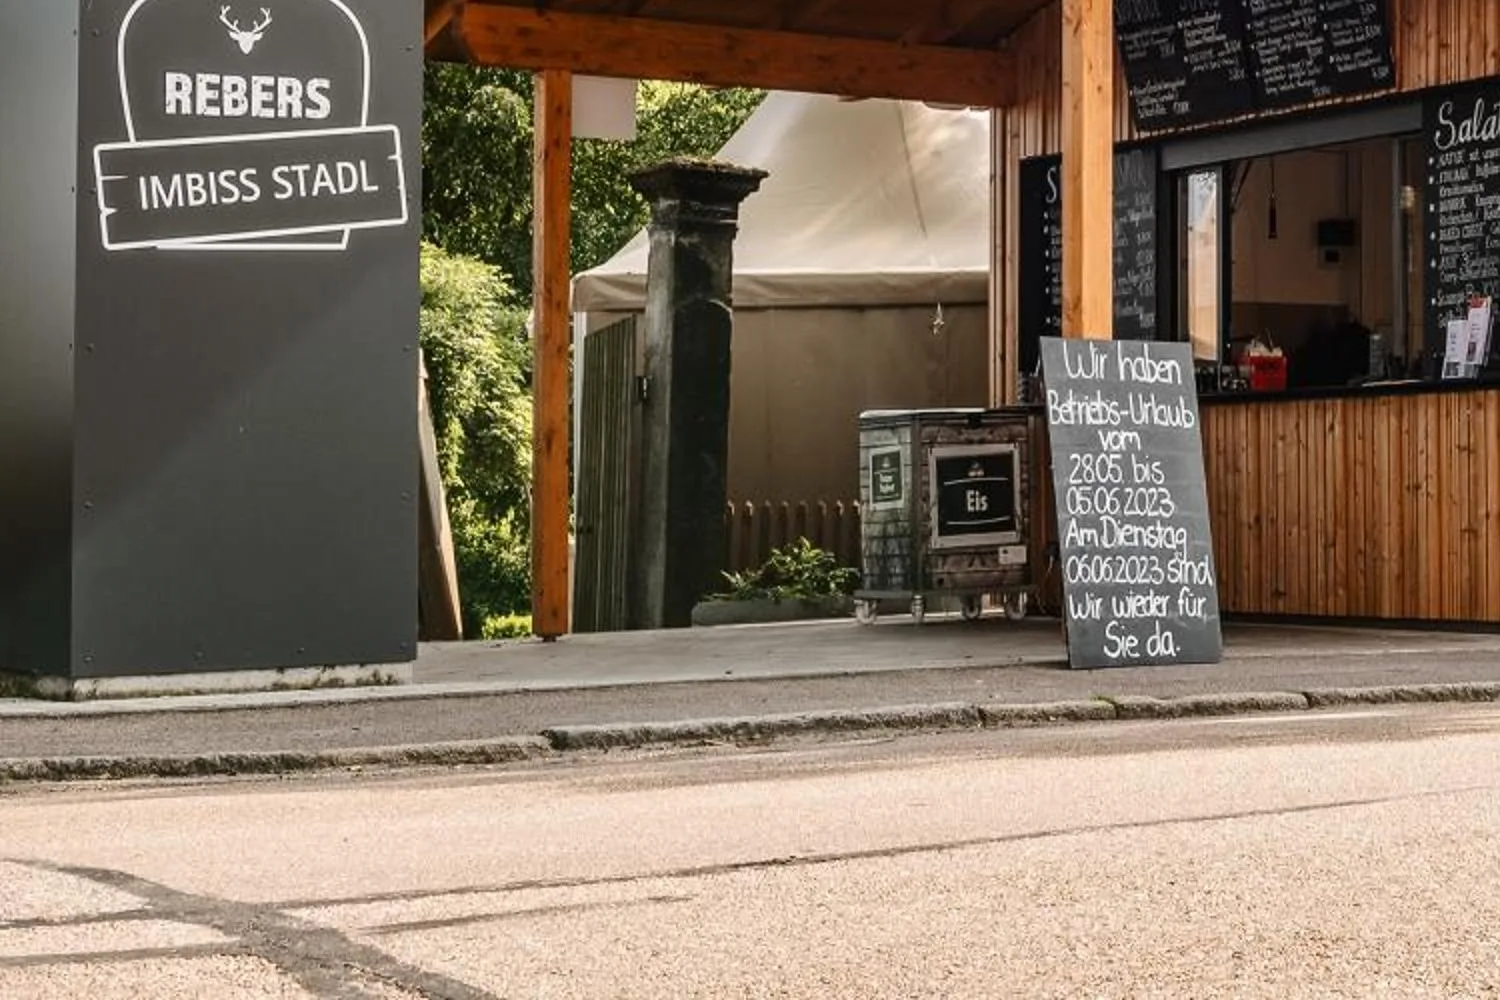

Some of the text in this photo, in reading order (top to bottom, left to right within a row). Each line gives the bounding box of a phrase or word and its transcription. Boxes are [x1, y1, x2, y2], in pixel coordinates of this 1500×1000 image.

[164, 71, 331, 119] REBERS
[139, 160, 379, 210] IMBISS STADL
[1063, 340, 1182, 385] Wir haben
[1098, 429, 1142, 451] vom
[1131, 453, 1165, 485] bis
[966, 490, 988, 512] Eis
[1065, 515, 1187, 562] Am Dienstag
[1167, 551, 1213, 587] sind
[1112, 589, 1170, 618] wieder
[1103, 620, 1140, 658] Sie
